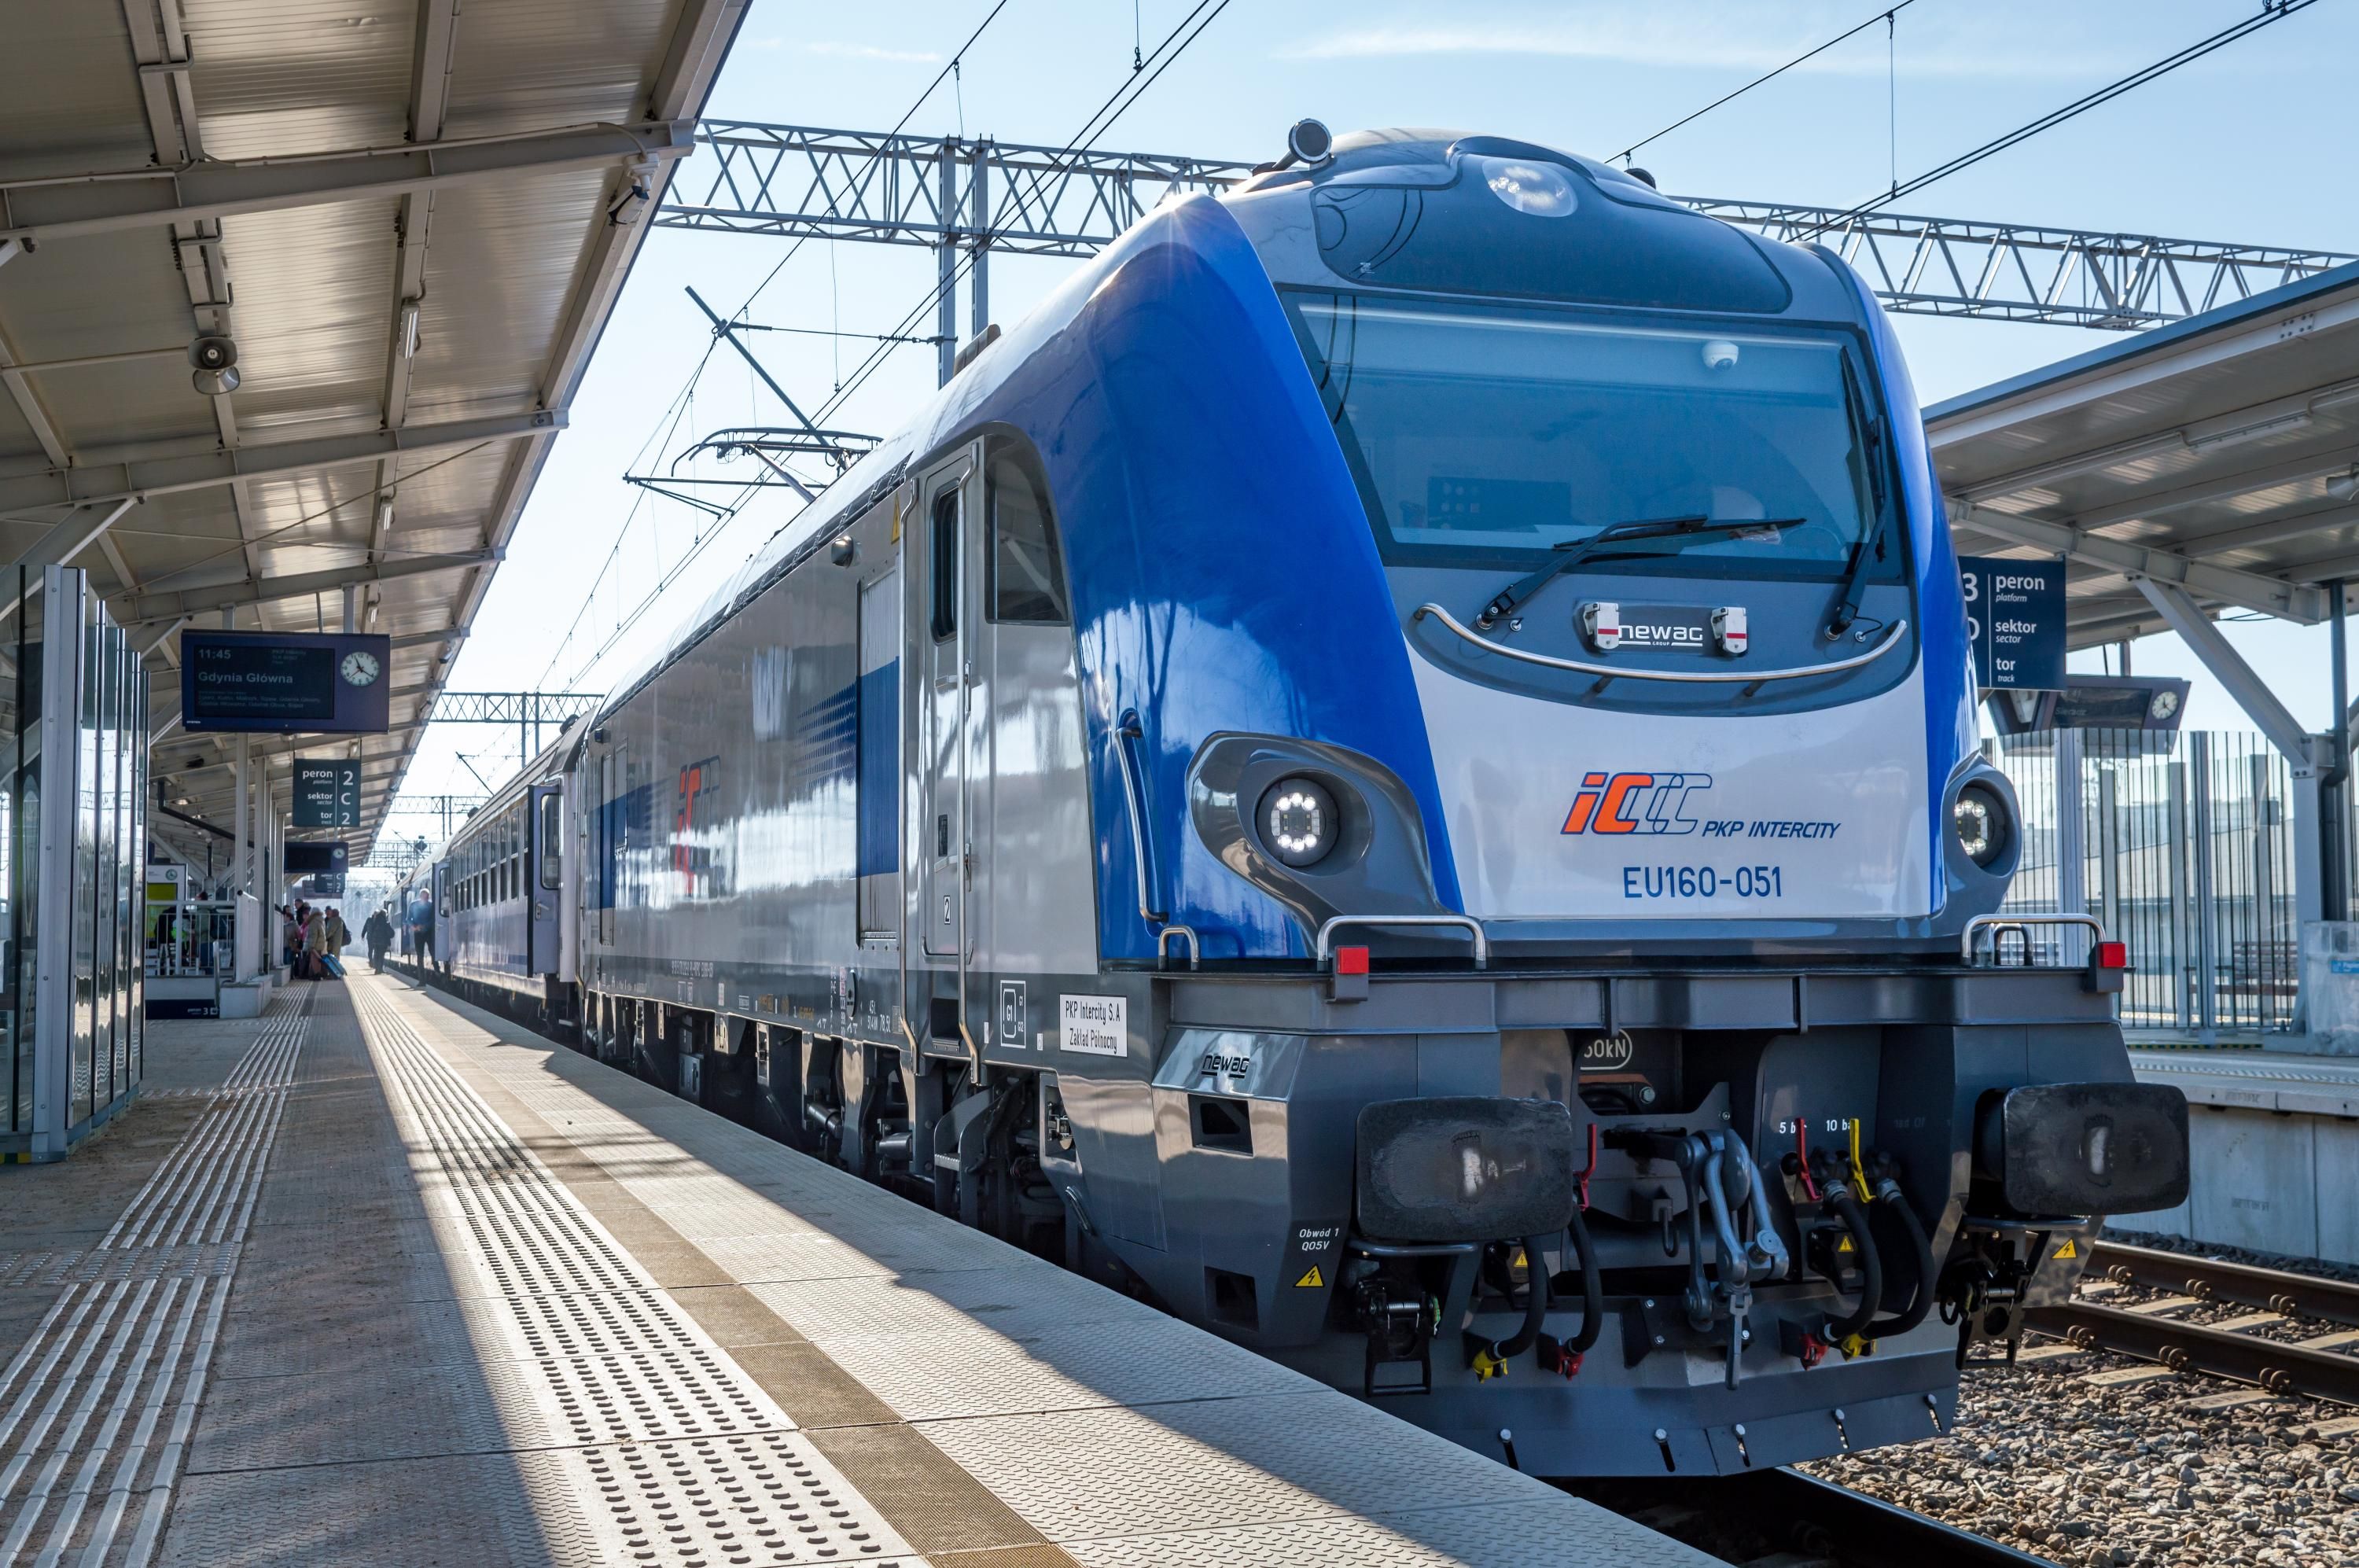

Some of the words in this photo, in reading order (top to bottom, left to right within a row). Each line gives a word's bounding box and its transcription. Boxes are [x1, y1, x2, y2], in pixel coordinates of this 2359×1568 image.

[1963, 572, 1978, 602] 3
[1996, 576, 2044, 592] peron
[1996, 593, 2027, 602] platform
[1996, 619, 2037, 633] sektor
[199, 649, 231, 660] 11:45
[1996, 657, 2015, 671] tor
[198, 672, 242, 684] Gdynia
[246, 672, 293, 683] Główna
[1998, 674, 2015, 683] track
[303, 771, 333, 780] peron
[343, 771, 354, 786] 2
[341, 793, 351, 805] C
[341, 812, 351, 825] 2
[1702, 821, 1744, 837] PKP
[1748, 822, 1842, 839] INTERCITY
[1623, 867, 1782, 898] EU160-051
[944, 897, 950, 922] 2
[1007, 1005, 1013, 1021] G1
[1065, 1000, 1078, 1018] PKP
[1080, 1000, 1106, 1025] Intercity
[1779, 1122, 1787, 1133] 5
[1826, 1120, 1837, 1131] 10
[1299, 1228, 1330, 1238] Obwód
[1334, 1228, 1339, 1237] 1
